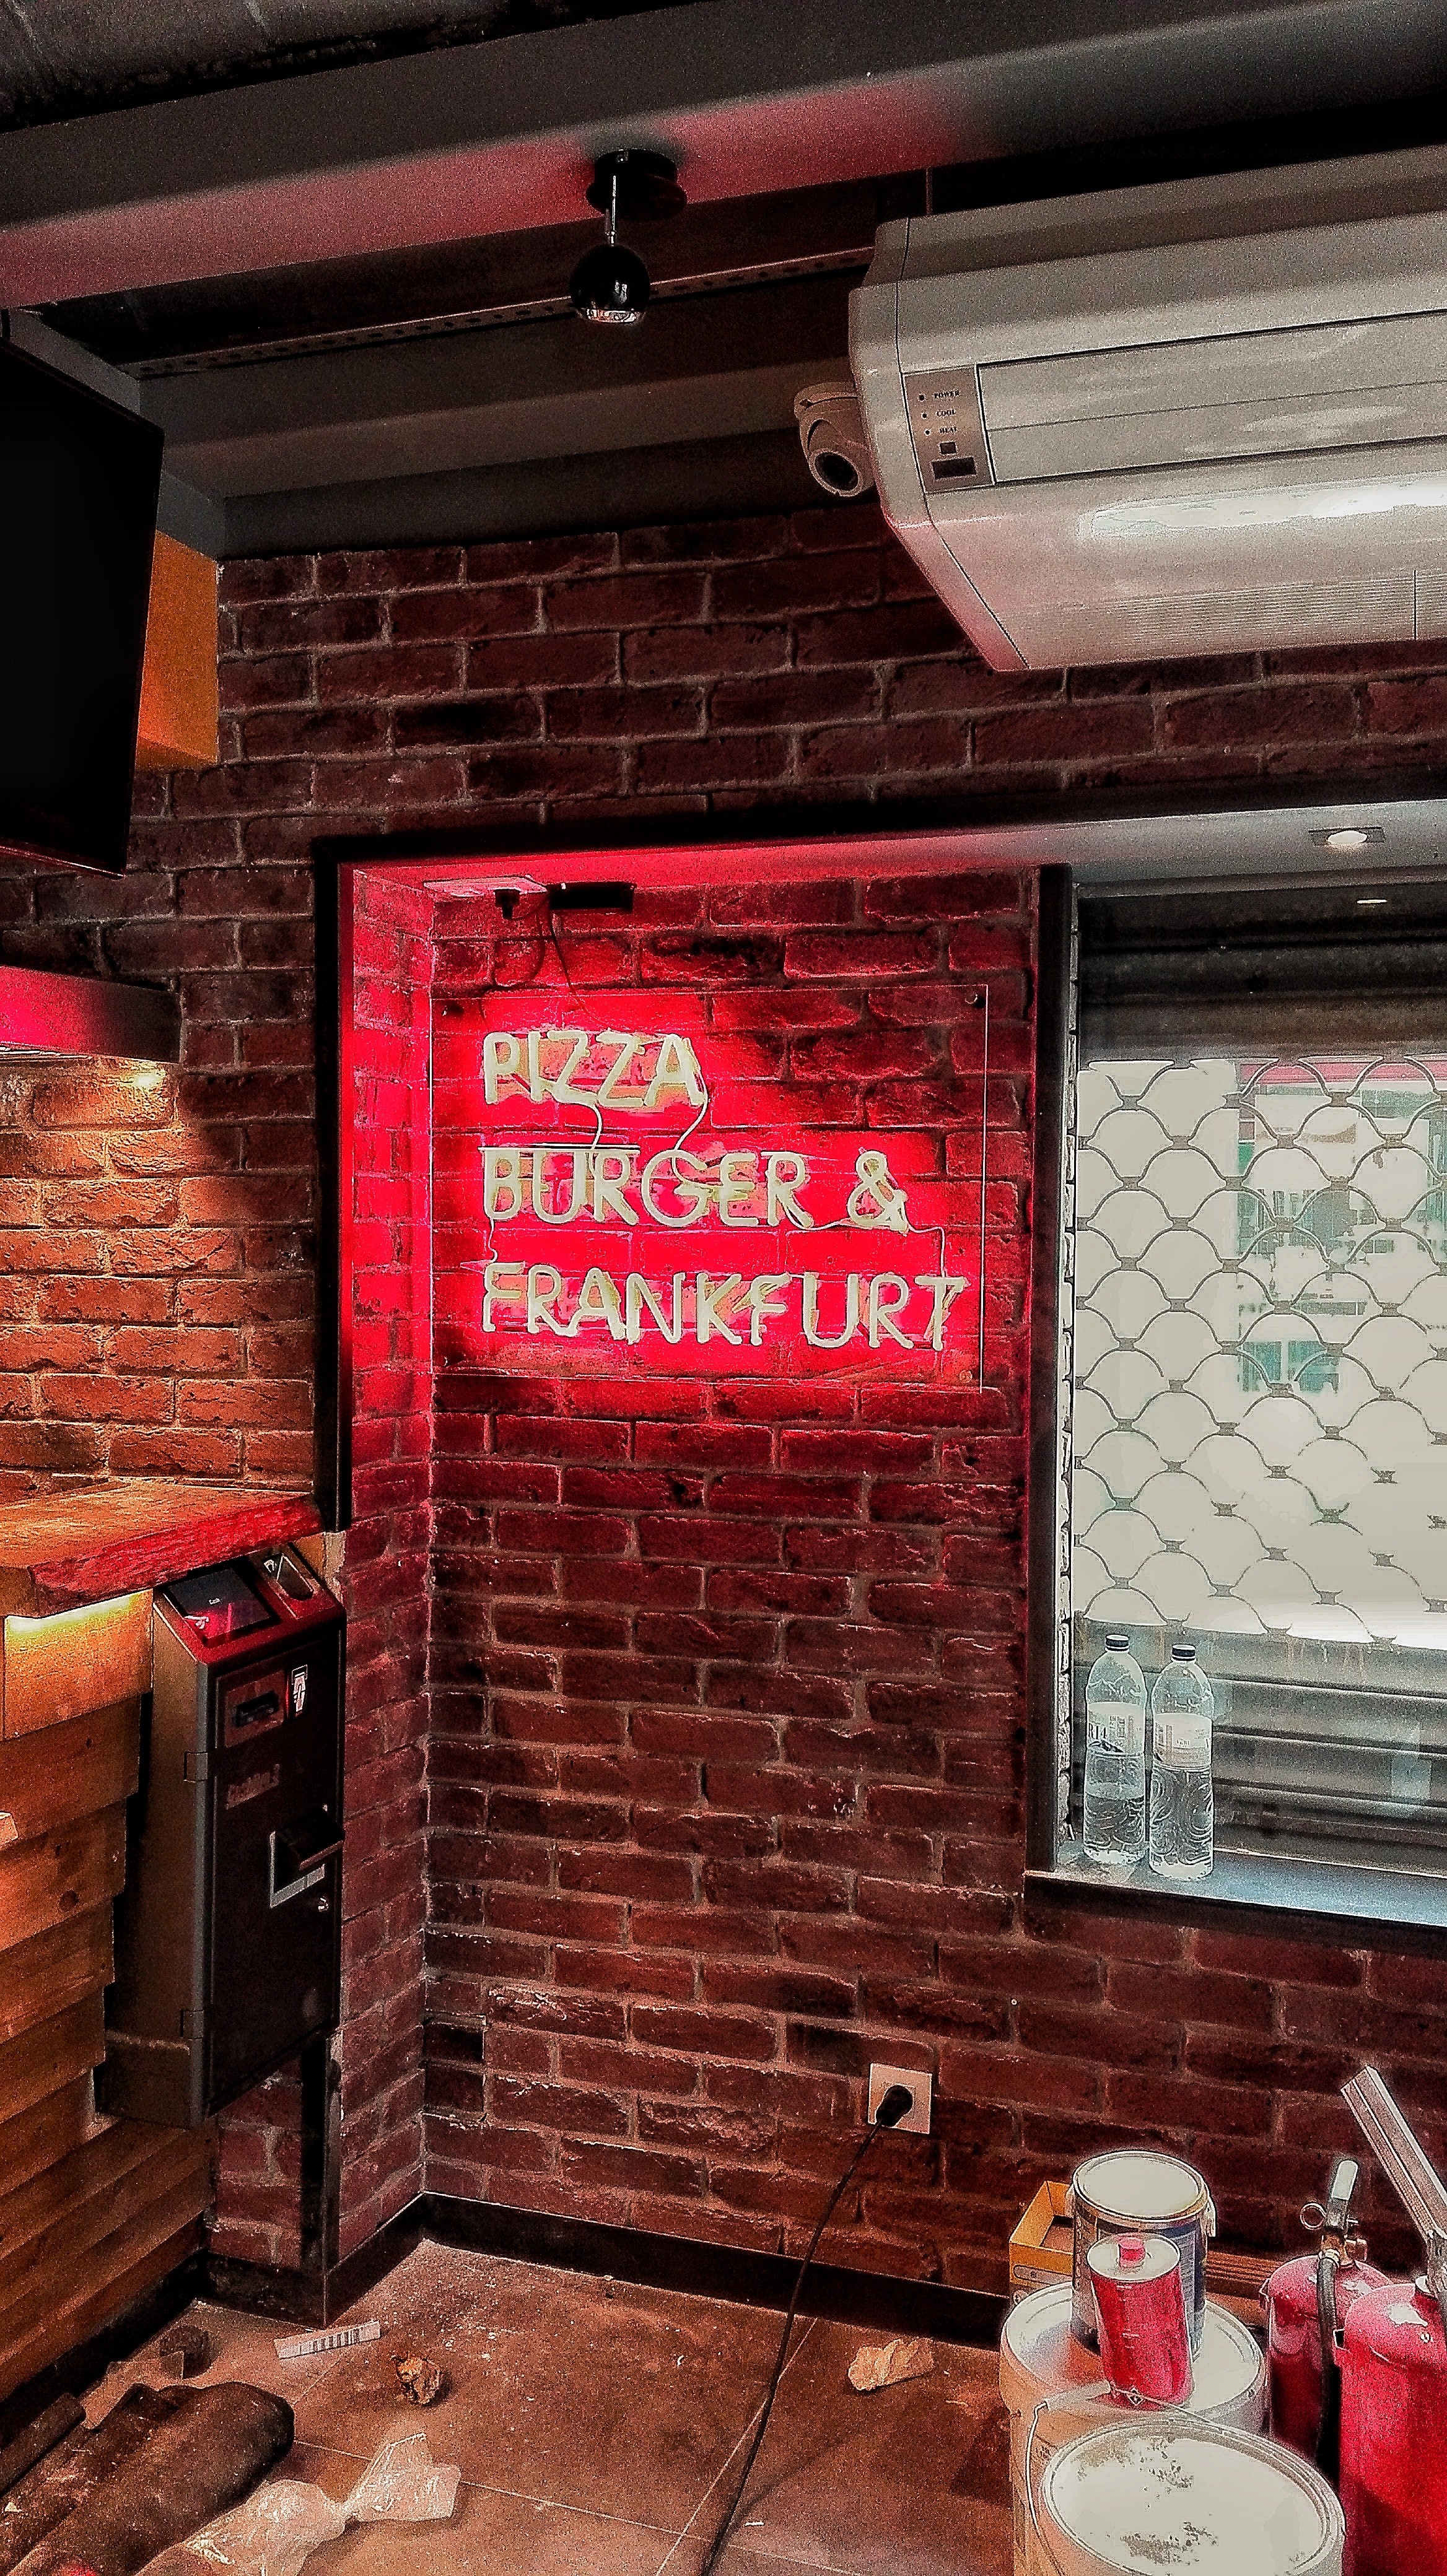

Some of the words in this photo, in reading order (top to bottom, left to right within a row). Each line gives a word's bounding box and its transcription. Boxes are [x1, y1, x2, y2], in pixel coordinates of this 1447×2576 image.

[933, 389, 960, 399] POWER
[936, 409, 956, 417] COOL
[483, 1030, 704, 1107] PIZZA
[483, 1149, 814, 1229] BURGER
[848, 1149, 909, 1234] &
[483, 1261, 968, 1351] FRANKFURT
